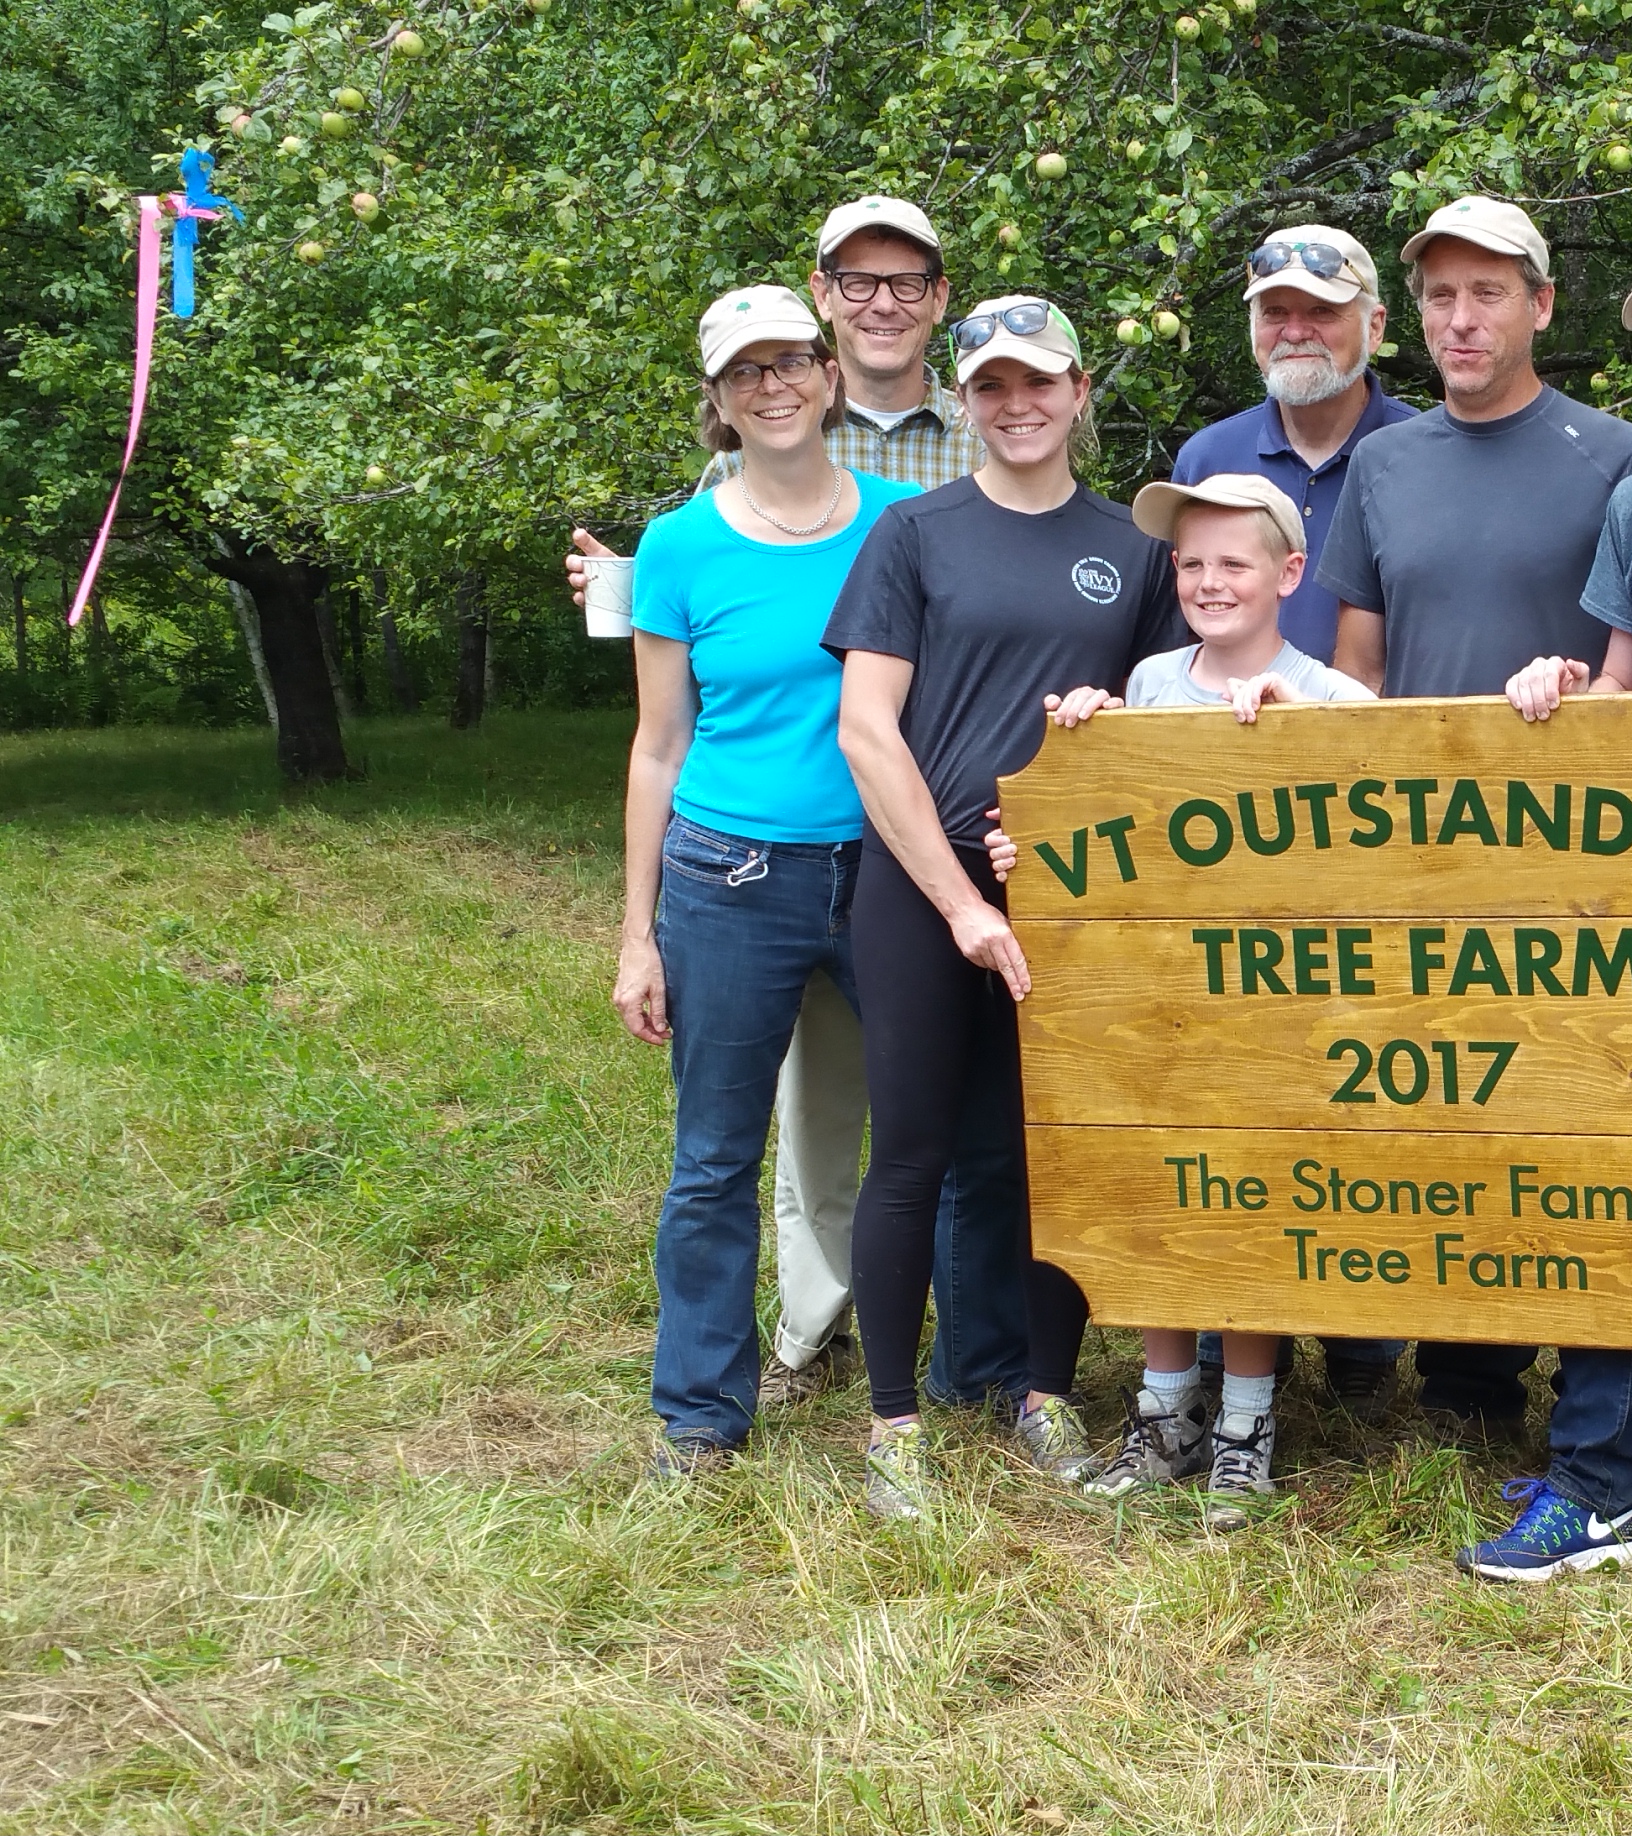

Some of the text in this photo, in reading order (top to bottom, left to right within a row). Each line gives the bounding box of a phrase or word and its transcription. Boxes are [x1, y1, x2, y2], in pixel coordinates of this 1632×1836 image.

[1089, 573, 1113, 588] IVY
[1034, 815, 1138, 897] VT
[1193, 928, 1375, 995] TREE
[1326, 1039, 1520, 1105] 2017
[1164, 1153, 1269, 1210] The
[1291, 1158, 1487, 1216] Stoner
[1284, 1228, 1589, 1291] Tree Farm
